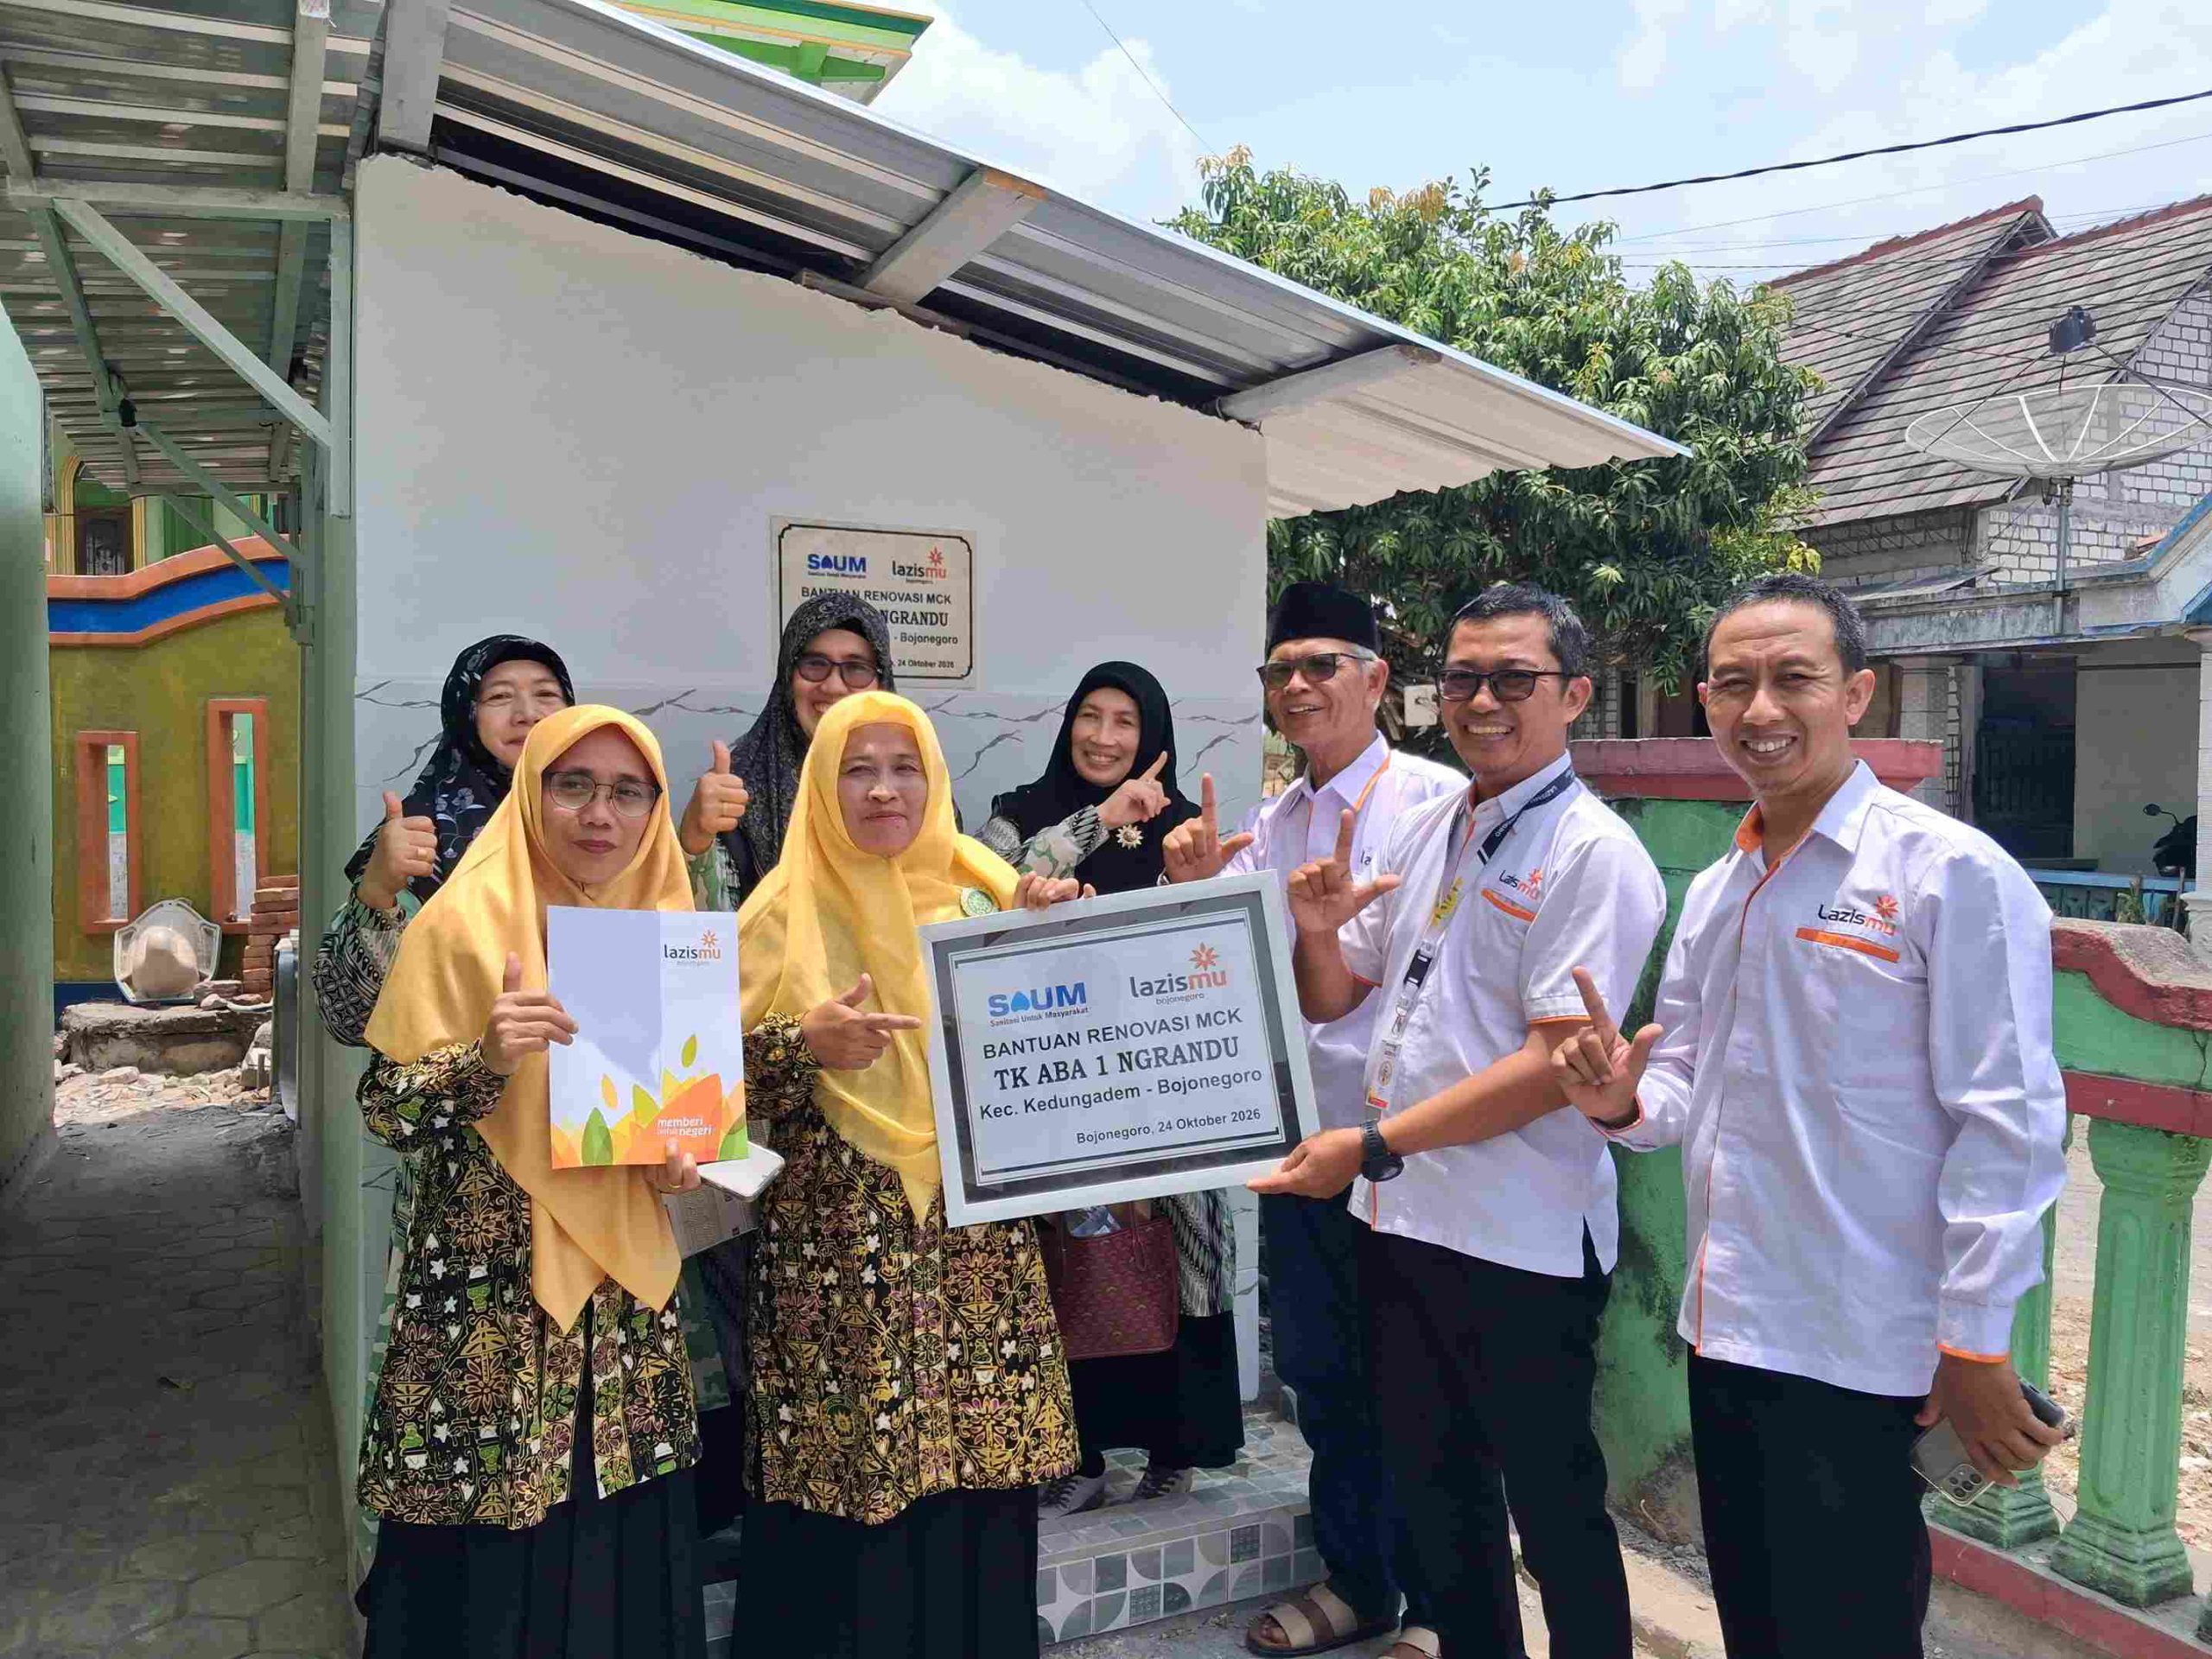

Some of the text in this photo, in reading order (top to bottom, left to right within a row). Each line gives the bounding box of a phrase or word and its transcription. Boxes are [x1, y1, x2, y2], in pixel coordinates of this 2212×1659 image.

[892, 560, 947, 579] lazismu
[864, 590, 923, 604] RENOVASI
[926, 594, 951, 605] MCK
[899, 632, 958, 645] Bojonegoro
[664, 944, 721, 959] lazismu
[1129, 969, 1228, 998] lazismu
[1155, 992, 1205, 1006] bojonegoro
[1021, 1014, 1043, 1023] Untuk
[1045, 1007, 1089, 1020] Masyarakat
[982, 1007, 1243, 1059] BANTUAN RENOVASI MCK
[994, 1036, 1239, 1090] TK ABA 1 NGRANDU
[980, 1103, 1019, 1121] Kec.
[1023, 1085, 1141, 1113] Kedungadem
[1157, 1069, 1263, 1096] Bojonegoro
[657, 1116, 703, 1128] memberi
[1076, 1108, 1262, 1145] Bojonegoro, 24 Oktober 2026
